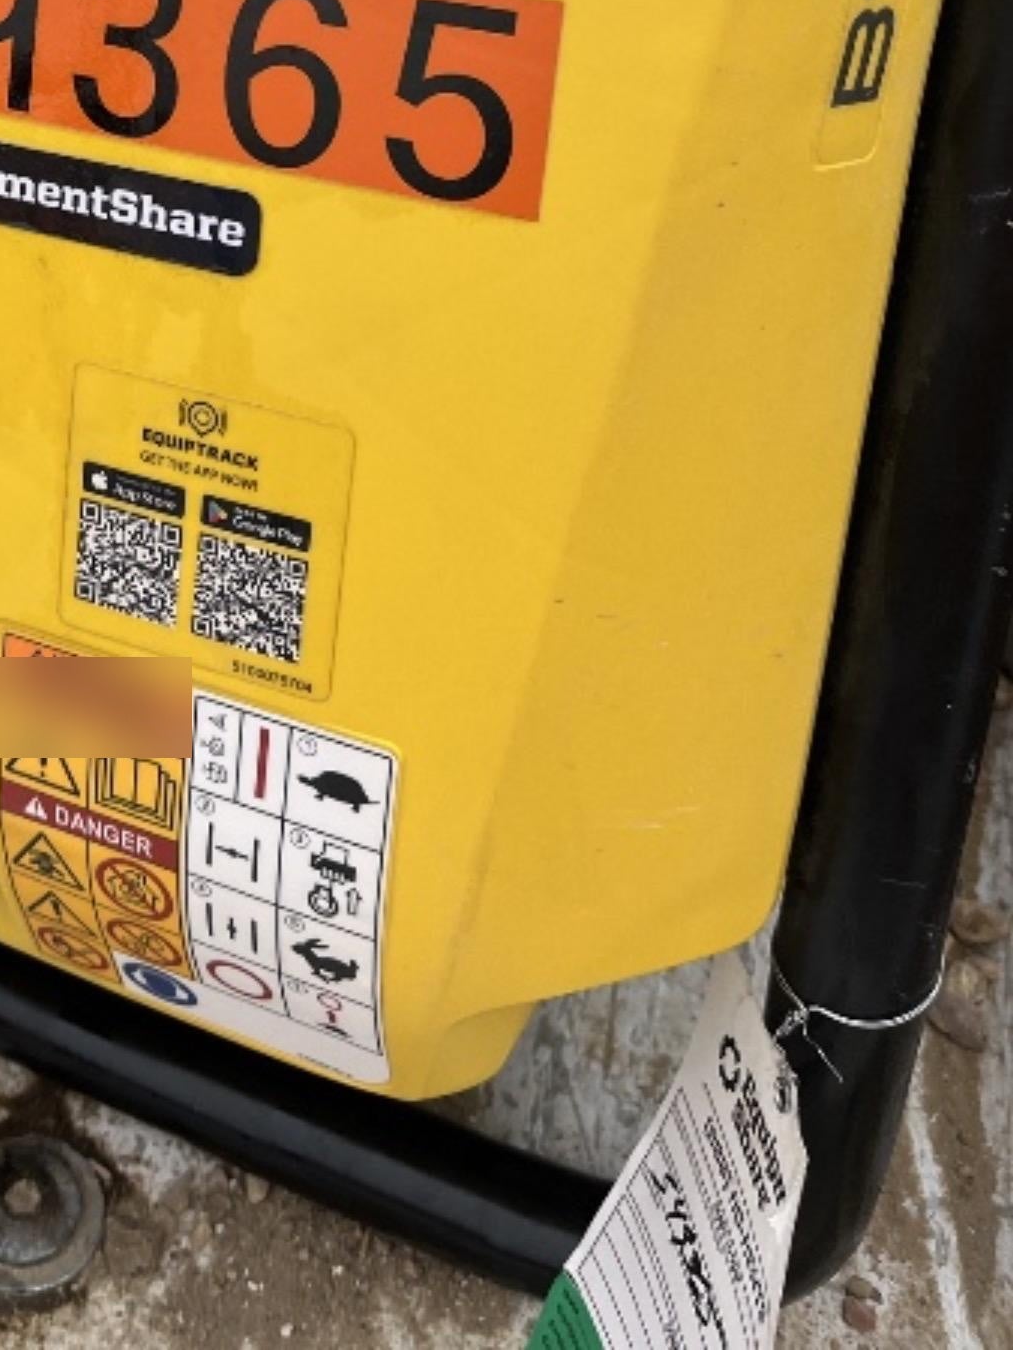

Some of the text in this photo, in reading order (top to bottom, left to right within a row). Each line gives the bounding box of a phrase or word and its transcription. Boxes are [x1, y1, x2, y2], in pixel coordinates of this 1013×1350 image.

[139, 450, 163, 468] GET
[192, 464, 219, 484] APP
[141, 427, 259, 472] EQUIPTRACK
[233, 513, 277, 539] Google
[278, 526, 304, 547] Play
[54, 805, 154, 860] DANGER
